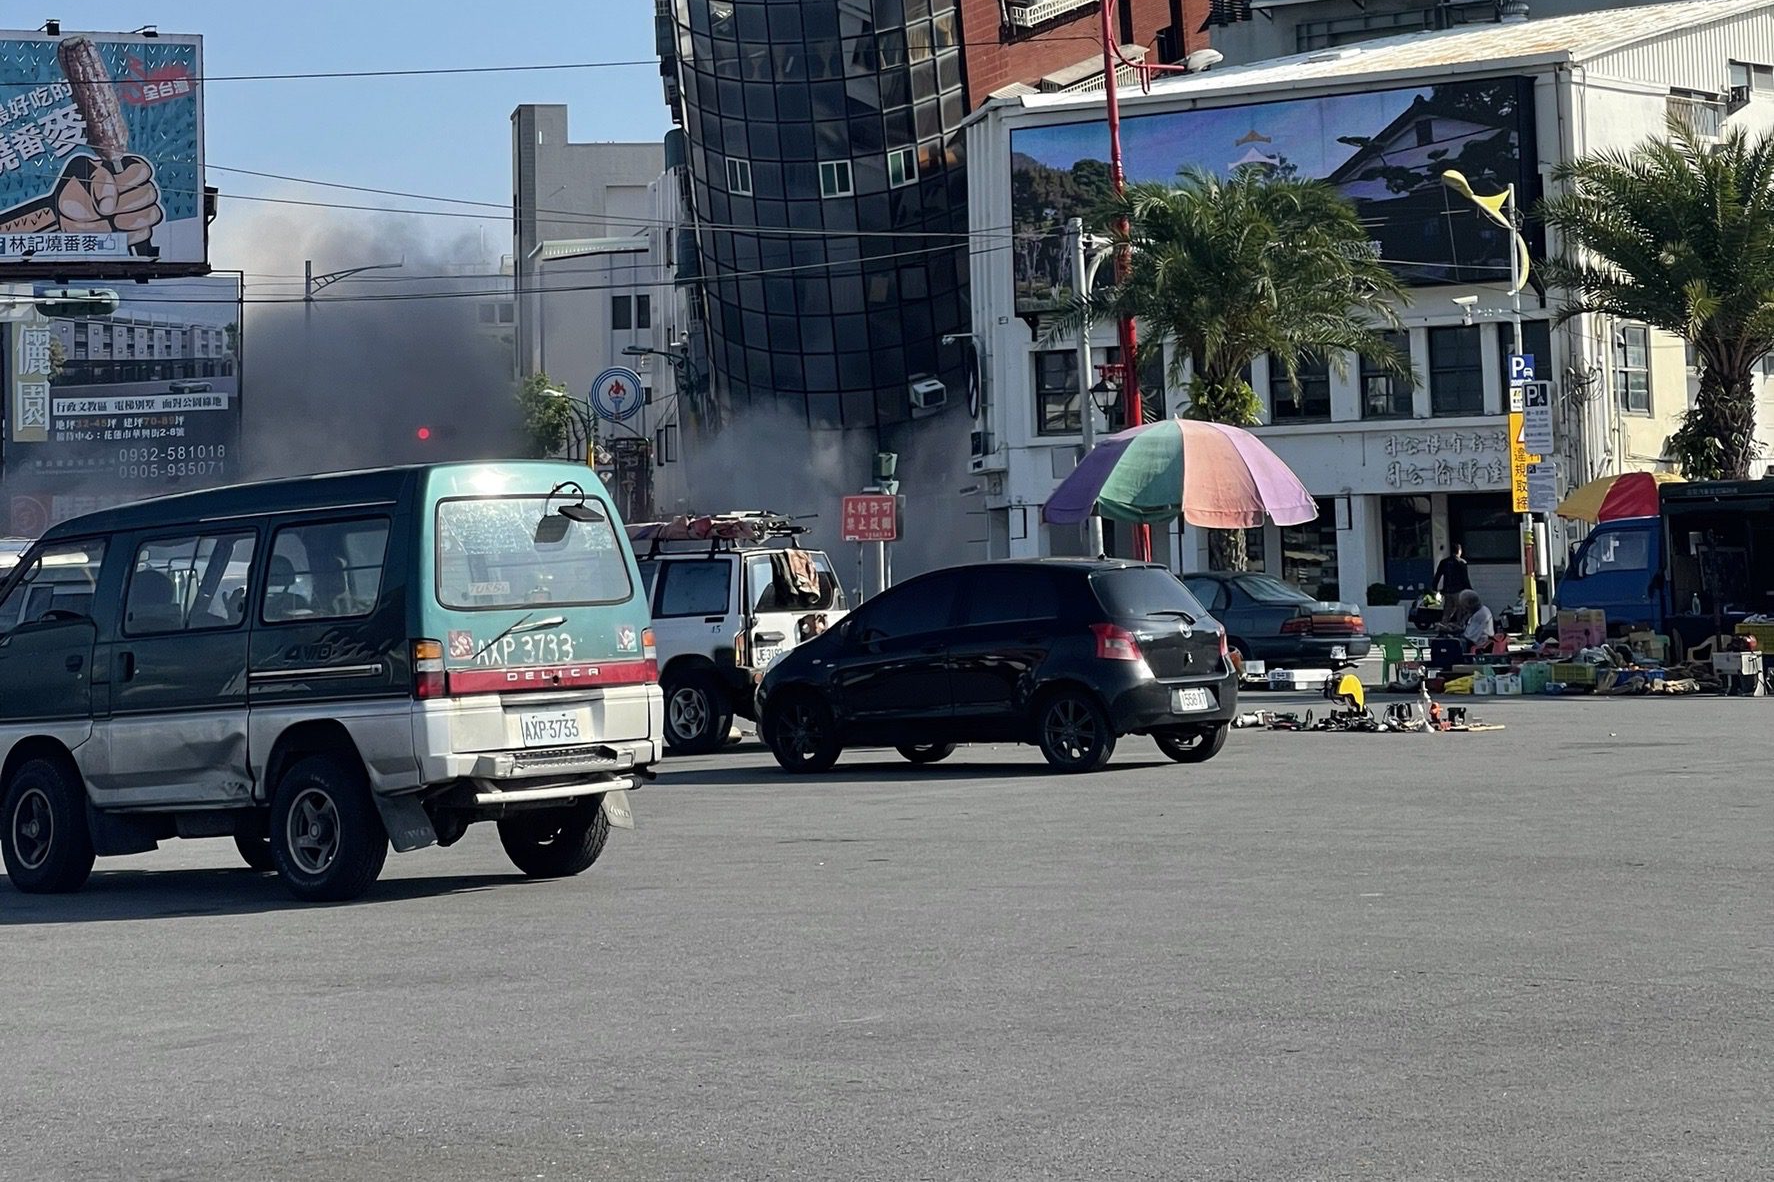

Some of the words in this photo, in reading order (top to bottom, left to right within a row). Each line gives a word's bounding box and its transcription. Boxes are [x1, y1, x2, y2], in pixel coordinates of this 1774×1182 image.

[9, 234, 98, 252] 林記燒番麥
[16, 312, 51, 432] 儷園
[1511, 356, 1525, 378] P
[1526, 385, 1538, 406] P
[119, 444, 226, 463] 0932-581018
[119, 461, 226, 479] 0905-935071
[477, 634, 515, 666] AXP
[521, 633, 574, 663] 3733
[506, 668, 599, 681] DELICA
